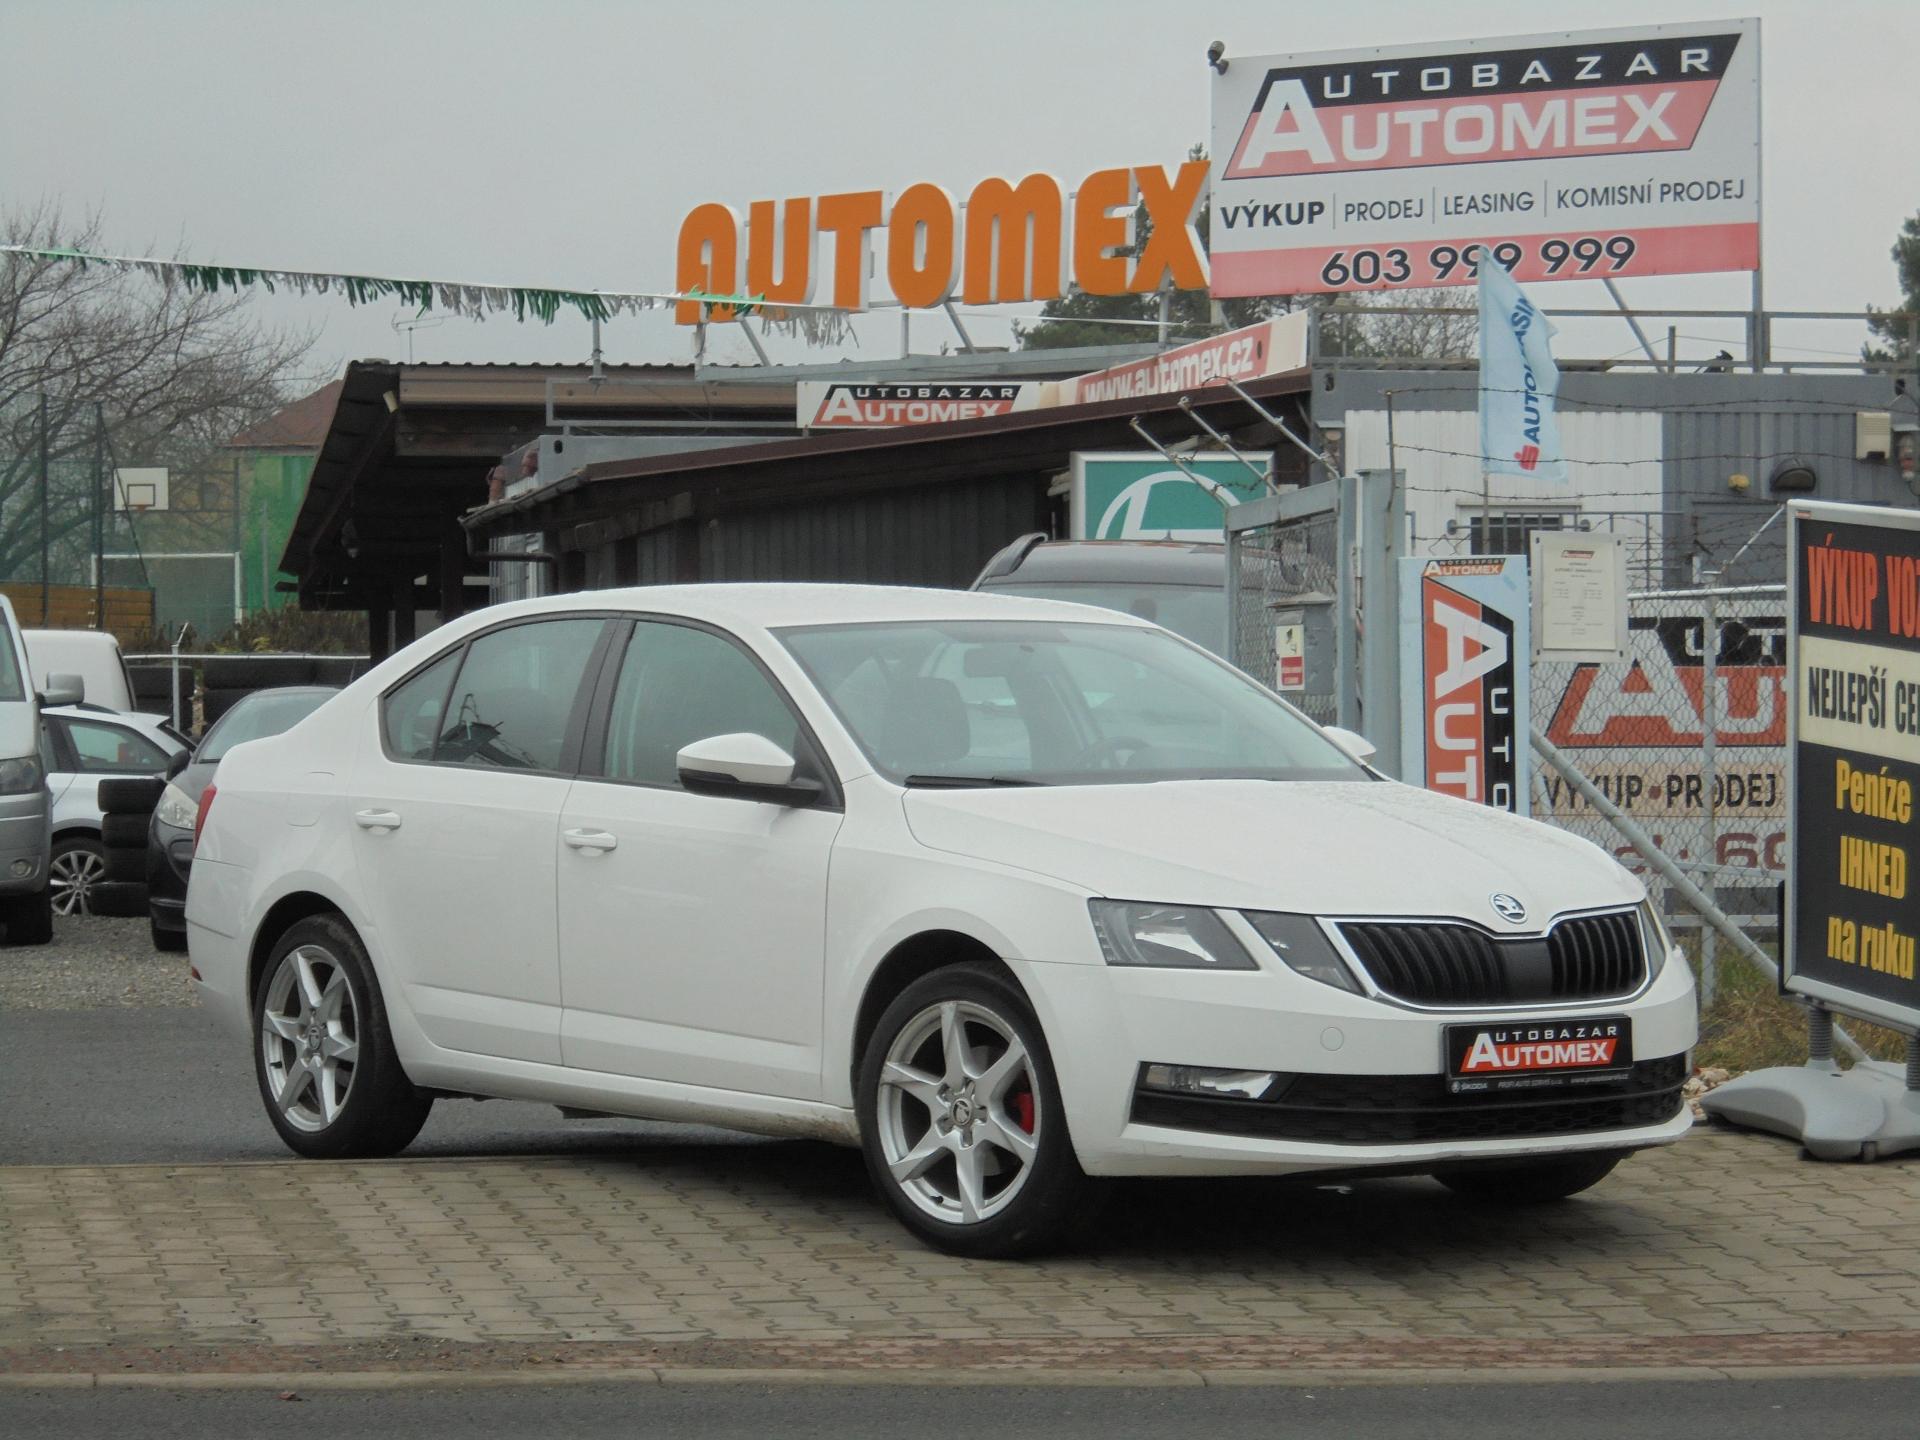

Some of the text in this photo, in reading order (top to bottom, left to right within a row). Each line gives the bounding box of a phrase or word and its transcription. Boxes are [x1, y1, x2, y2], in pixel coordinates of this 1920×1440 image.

[1238, 80, 1678, 169] AUTOMEX
[1220, 178, 1745, 229] VÝKUP PRODEJ LEASING KOMISNÍ PRODEJ
[675, 161, 1211, 324] AUTOMEX
[1321, 236, 1636, 286] 603 999 999
[1085, 337, 1254, 404] www.automex.cz
[821, 388, 1000, 422] AUTOMEX
[1807, 533, 1878, 631] VÝKUP
[1569, 629, 1786, 734] AU
[1808, 665, 1920, 736] NEJLEPŠÍ CE
[1836, 759, 1912, 824] Peníze
[1840, 835, 1906, 899] IHNED
[1827, 917, 1915, 980] na ruku
[1467, 1033, 1609, 1069] AUTOMEX
